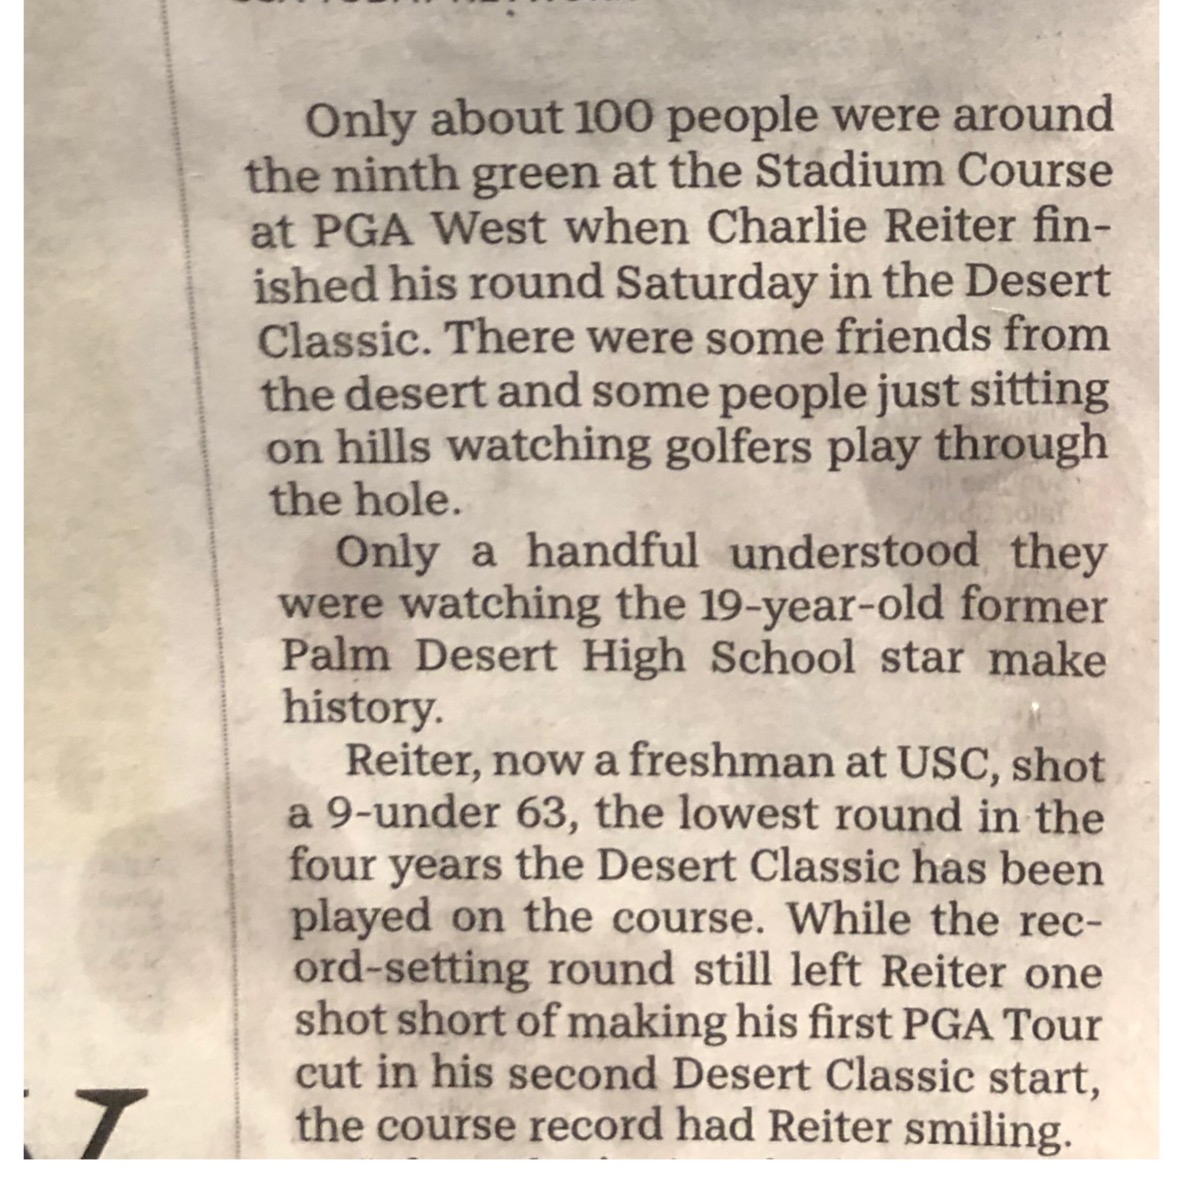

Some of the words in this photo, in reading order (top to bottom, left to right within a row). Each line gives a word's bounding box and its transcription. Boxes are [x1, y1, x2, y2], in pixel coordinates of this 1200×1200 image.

[305, 98, 418, 147] Only
[430, 96, 565, 137] about
[573, 97, 655, 135] 100
[666, 93, 819, 143] people
[830, 104, 941, 132] were
[953, 92, 1115, 133] around
[243, 154, 321, 195] the
[331, 153, 461, 194] ninth
[472, 162, 601, 201] green
[613, 155, 657, 190] at
[668, 149, 743, 189] the
[756, 149, 946, 189] Stadium
[957, 151, 1114, 188] Course
[250, 214, 296, 250] at
[312, 212, 415, 249] PGA
[429, 210, 548, 246] West
[563, 205, 690, 246] when
[708, 204, 867, 245] Charlie
[884, 205, 1017, 243] Reiter
[1032, 203, 1112, 243] fin-
[253, 263, 379, 305] ished
[388, 263, 458, 302] his
[469, 261, 605, 300] round
[616, 261, 819, 310] Saturday
[829, 262, 873, 300] in
[882, 259, 954, 300] the
[964, 262, 1112, 298] Desert
[258, 320, 432, 360] Classic.
[443, 316, 575, 355] There
[585, 326, 694, 355] were
[706, 328, 825, 356] some
[835, 313, 992, 355] friends
[1003, 313, 1111, 352] from
[259, 374, 335, 413] the
[344, 374, 489, 412] desert
[497, 369, 582, 409] and
[592, 380, 710, 410] some
[718, 371, 868, 420] people
[875, 372, 960, 419] just
[970, 369, 1110, 416] sitting
[266, 438, 324, 466] on
[335, 426, 431, 465] hills
[445, 423, 653, 471] watching
[665, 425, 812, 471] golfers
[827, 425, 923, 473] play
[933, 420, 1109, 471] through
[268, 479, 342, 517] the
[353, 479, 461, 518] hole.
[335, 532, 441, 578] Only
[471, 541, 498, 568] a
[526, 529, 700, 569] handful
[728, 528, 980, 571] understood
[1009, 530, 1109, 580] they
[277, 593, 385, 620] were
[398, 583, 602, 629] watching
[615, 583, 687, 622] the
[699, 582, 945, 633] 19-year-old
[960, 583, 1109, 625] former
[281, 634, 392, 672] Palm
[414, 637, 558, 673] Desert
[582, 635, 687, 682] High
[711, 637, 856, 675] School
[881, 640, 965, 674] star
[988, 639, 1107, 679] make
[282, 687, 443, 734] history.
[346, 741, 481, 783] Reiter,
[492, 750, 585, 777] now
[594, 750, 620, 777] a
[629, 739, 836, 779] freshman
[845, 745, 888, 779] at
[897, 745, 1000, 788] USC,
[1012, 745, 1106, 784] shot
[287, 803, 314, 830] a
[327, 792, 501, 830] 9-under
[516, 795, 578, 836] 63,
[594, 792, 665, 830] the
[678, 792, 819, 831] lowest
[835, 795, 963, 834] round
[978, 798, 1021, 834] in
[1034, 797, 1105, 836] the
[288, 844, 377, 882] four
[388, 854, 503, 890] years
[514, 844, 584, 881] the
[597, 847, 737, 883] Desert
[750, 845, 900, 884] Classic
[911, 847, 987, 885] has
[999, 849, 1105, 887] been
[289, 895, 433, 942] played
[451, 906, 506, 933] on
[523, 896, 593, 934] the
[612, 908, 764, 935] course.
[785, 898, 912, 936] While
[929, 899, 1000, 937] the
[1019, 911, 1103, 938] rec-
[293, 947, 531, 995] ord-setting
[548, 948, 675, 986] round
[694, 949, 773, 986] still
[790, 950, 862, 988] left
[881, 953, 1007, 989] Reiter
[1024, 963, 1103, 990] one
[295, 998, 388, 1037] shot
[396, 999, 508, 1038] short
[516, 1000, 562, 1038] of
[567, 1001, 728, 1047] making
[735, 1002, 798, 1039] his
[808, 1002, 893, 1041] first
[902, 1006, 995, 1041] PGA
[1002, 1007, 1103, 1042] Tour
[295, 1056, 363, 1090] cut
[377, 1052, 419, 1089] in
[431, 1051, 494, 1090] his
[508, 1054, 659, 1091] second
[672, 1056, 812, 1092] Desert
[825, 1054, 975, 1094] Classic
[989, 1061, 1100, 1102] start,
[294, 1104, 365, 1144] the
[376, 1114, 517, 1143] course
[528, 1104, 665, 1143] record
[675, 1104, 756, 1142] had
[768, 1108, 893, 1144] Reiter
[904, 1109, 1072, 1158] smiling.
